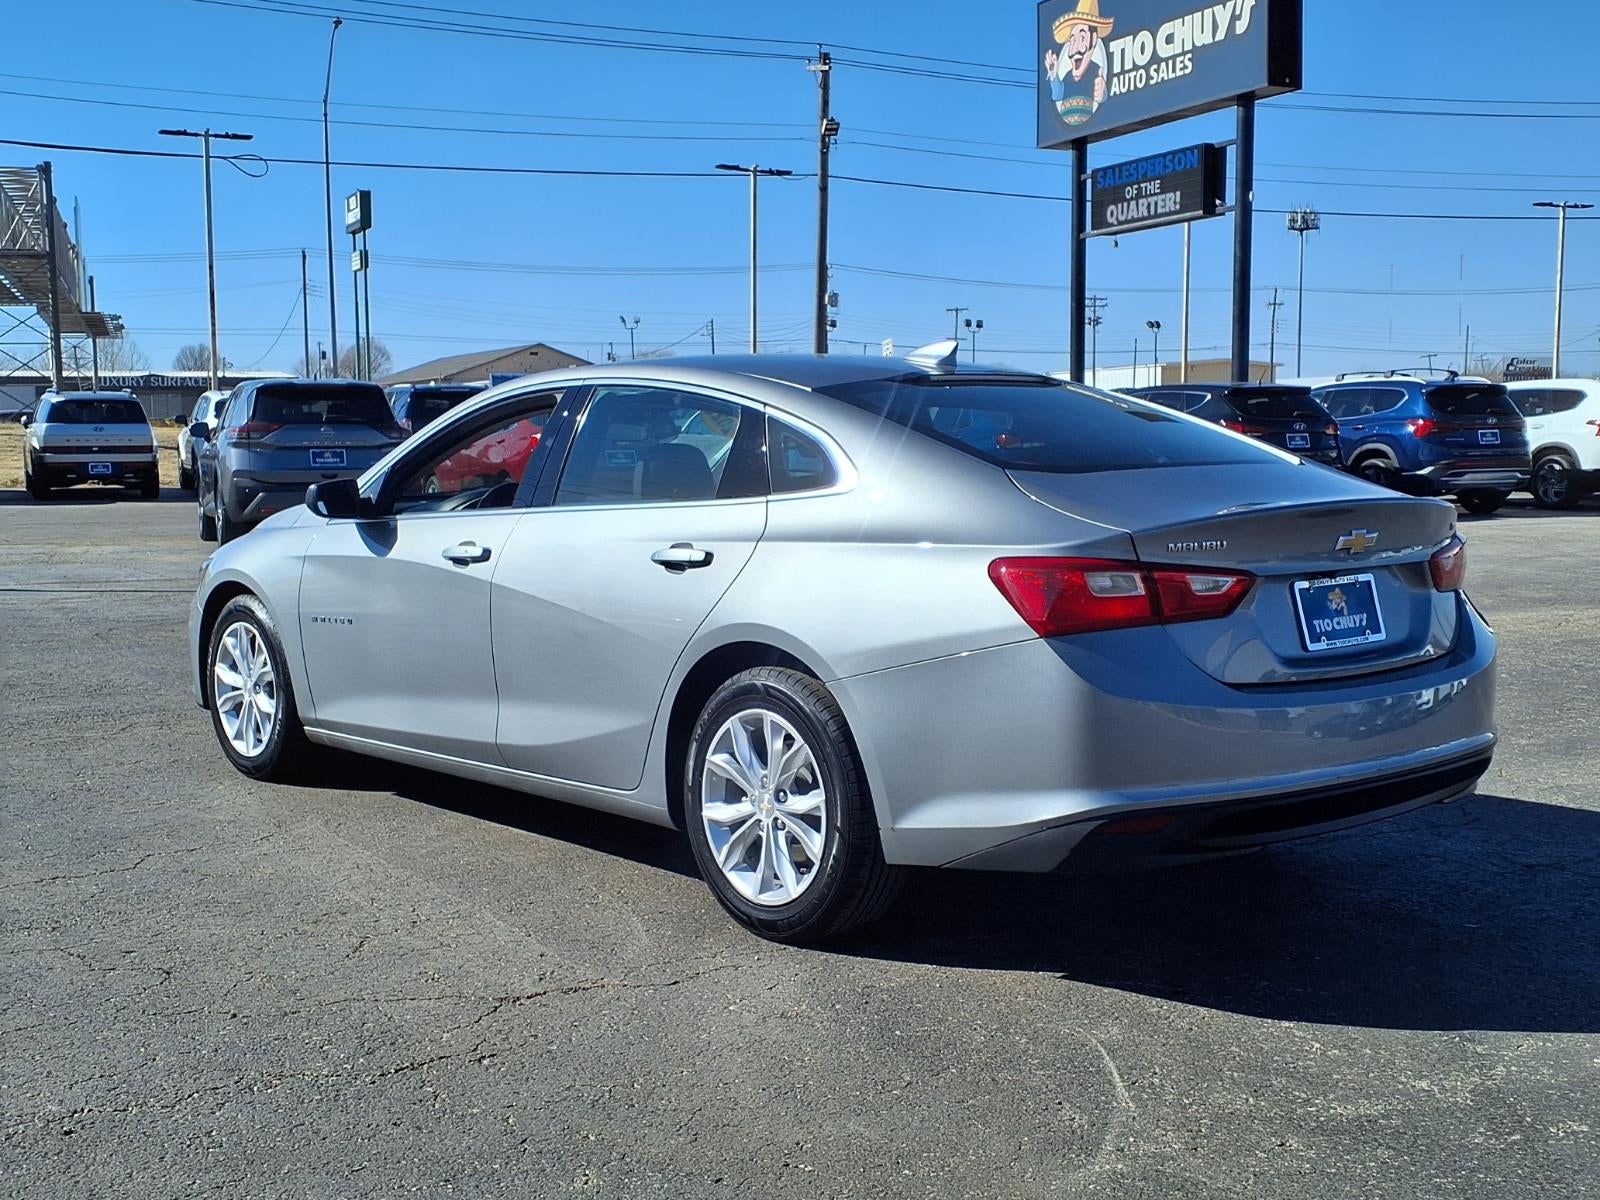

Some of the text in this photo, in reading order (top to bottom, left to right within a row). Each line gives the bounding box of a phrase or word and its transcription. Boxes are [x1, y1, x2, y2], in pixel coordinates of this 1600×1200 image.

[1109, 0, 1256, 74] TIO CHUY'S
[1109, 53, 1193, 97] AUTO SALES
[1096, 148, 1198, 189] SALESPERSON
[1124, 179, 1161, 199] OF THE
[1106, 190, 1181, 225] QUARTER!
[100, 376, 145, 387] UXURY
[1167, 540, 1228, 553] MALIBU
[1312, 612, 1368, 633] TIO CHUY'S
